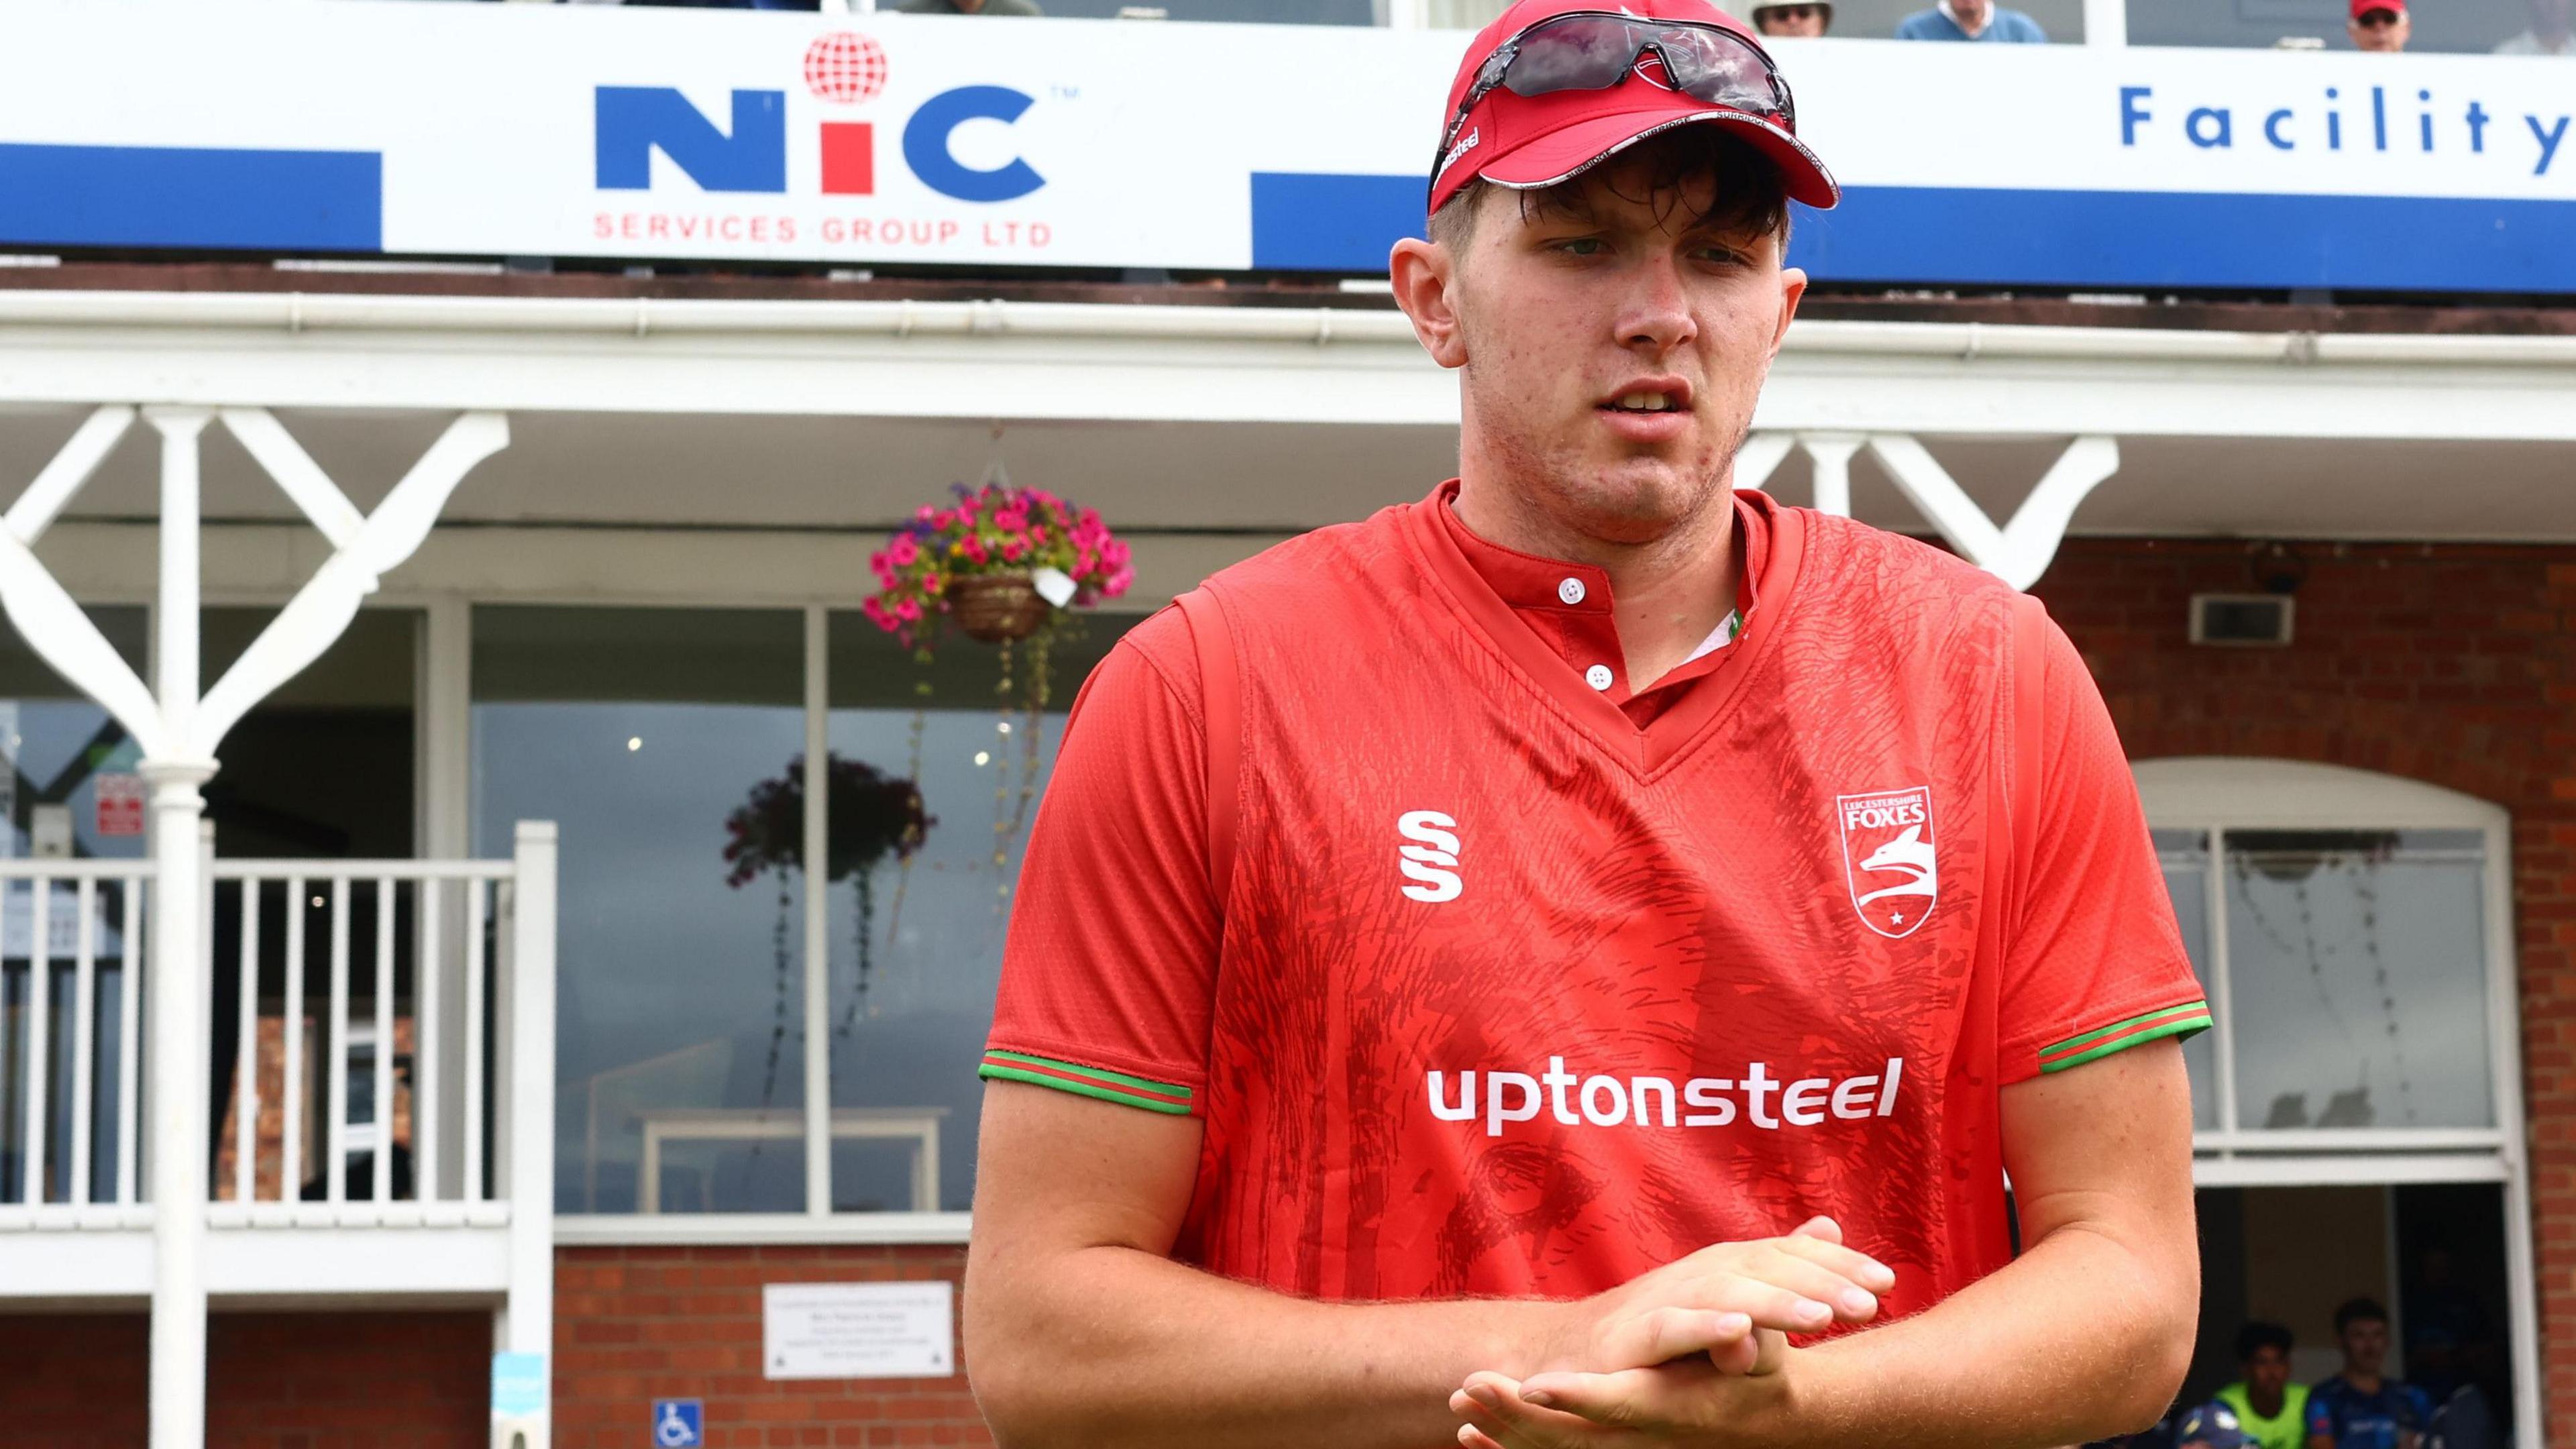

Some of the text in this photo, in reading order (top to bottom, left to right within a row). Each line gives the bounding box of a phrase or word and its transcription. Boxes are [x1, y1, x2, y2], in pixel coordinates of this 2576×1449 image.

[1716, 111, 1768, 128] SURRIDGE
[2120, 87, 2571, 176] Facility
[594, 213, 1052, 248] SERVICES GROUP LTD
[1845, 794, 1923, 810] LEICESTERSHIRE
[1846, 803, 1926, 830] FOXES
[1427, 1056, 1902, 1136] uptonsteel
